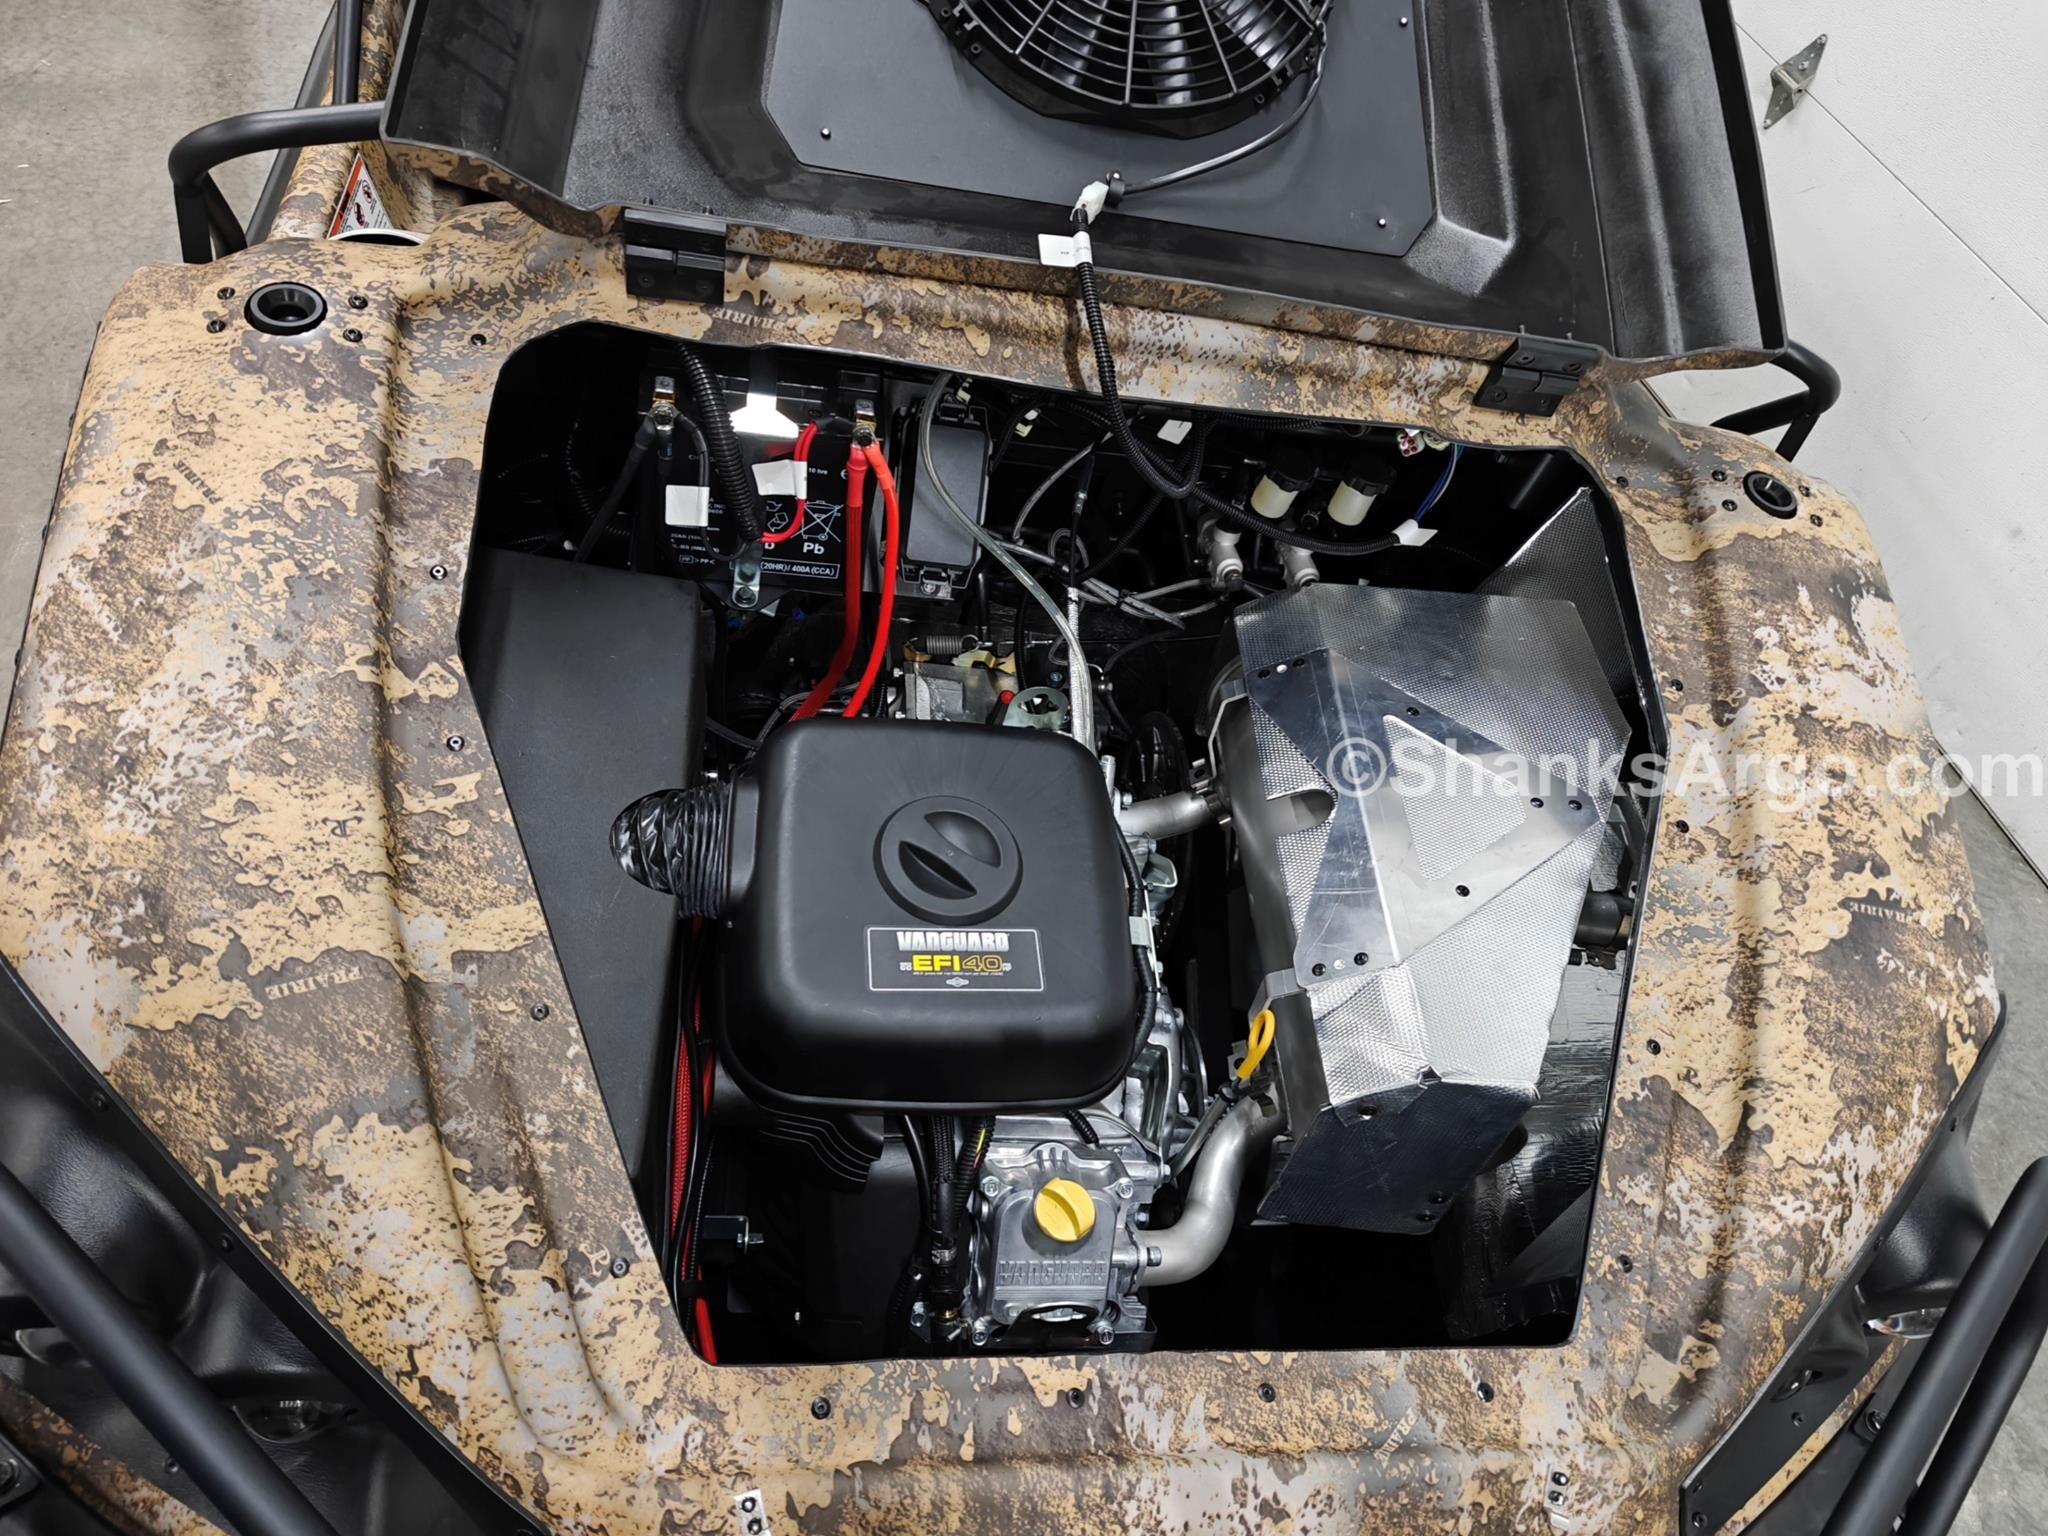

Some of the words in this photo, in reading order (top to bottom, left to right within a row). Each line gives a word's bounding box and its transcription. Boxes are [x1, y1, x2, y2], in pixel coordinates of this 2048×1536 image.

[173, 459, 223, 505] PRAIRIE
[803, 542, 825, 554] Pb
[791, 565, 810, 573] 400A
[811, 566, 835, 576] (CCA)
[896, 931, 1010, 952] VANGUARD
[264, 966, 364, 1001] PRAIRIE
[998, 1260, 1108, 1286] VANGUARD
